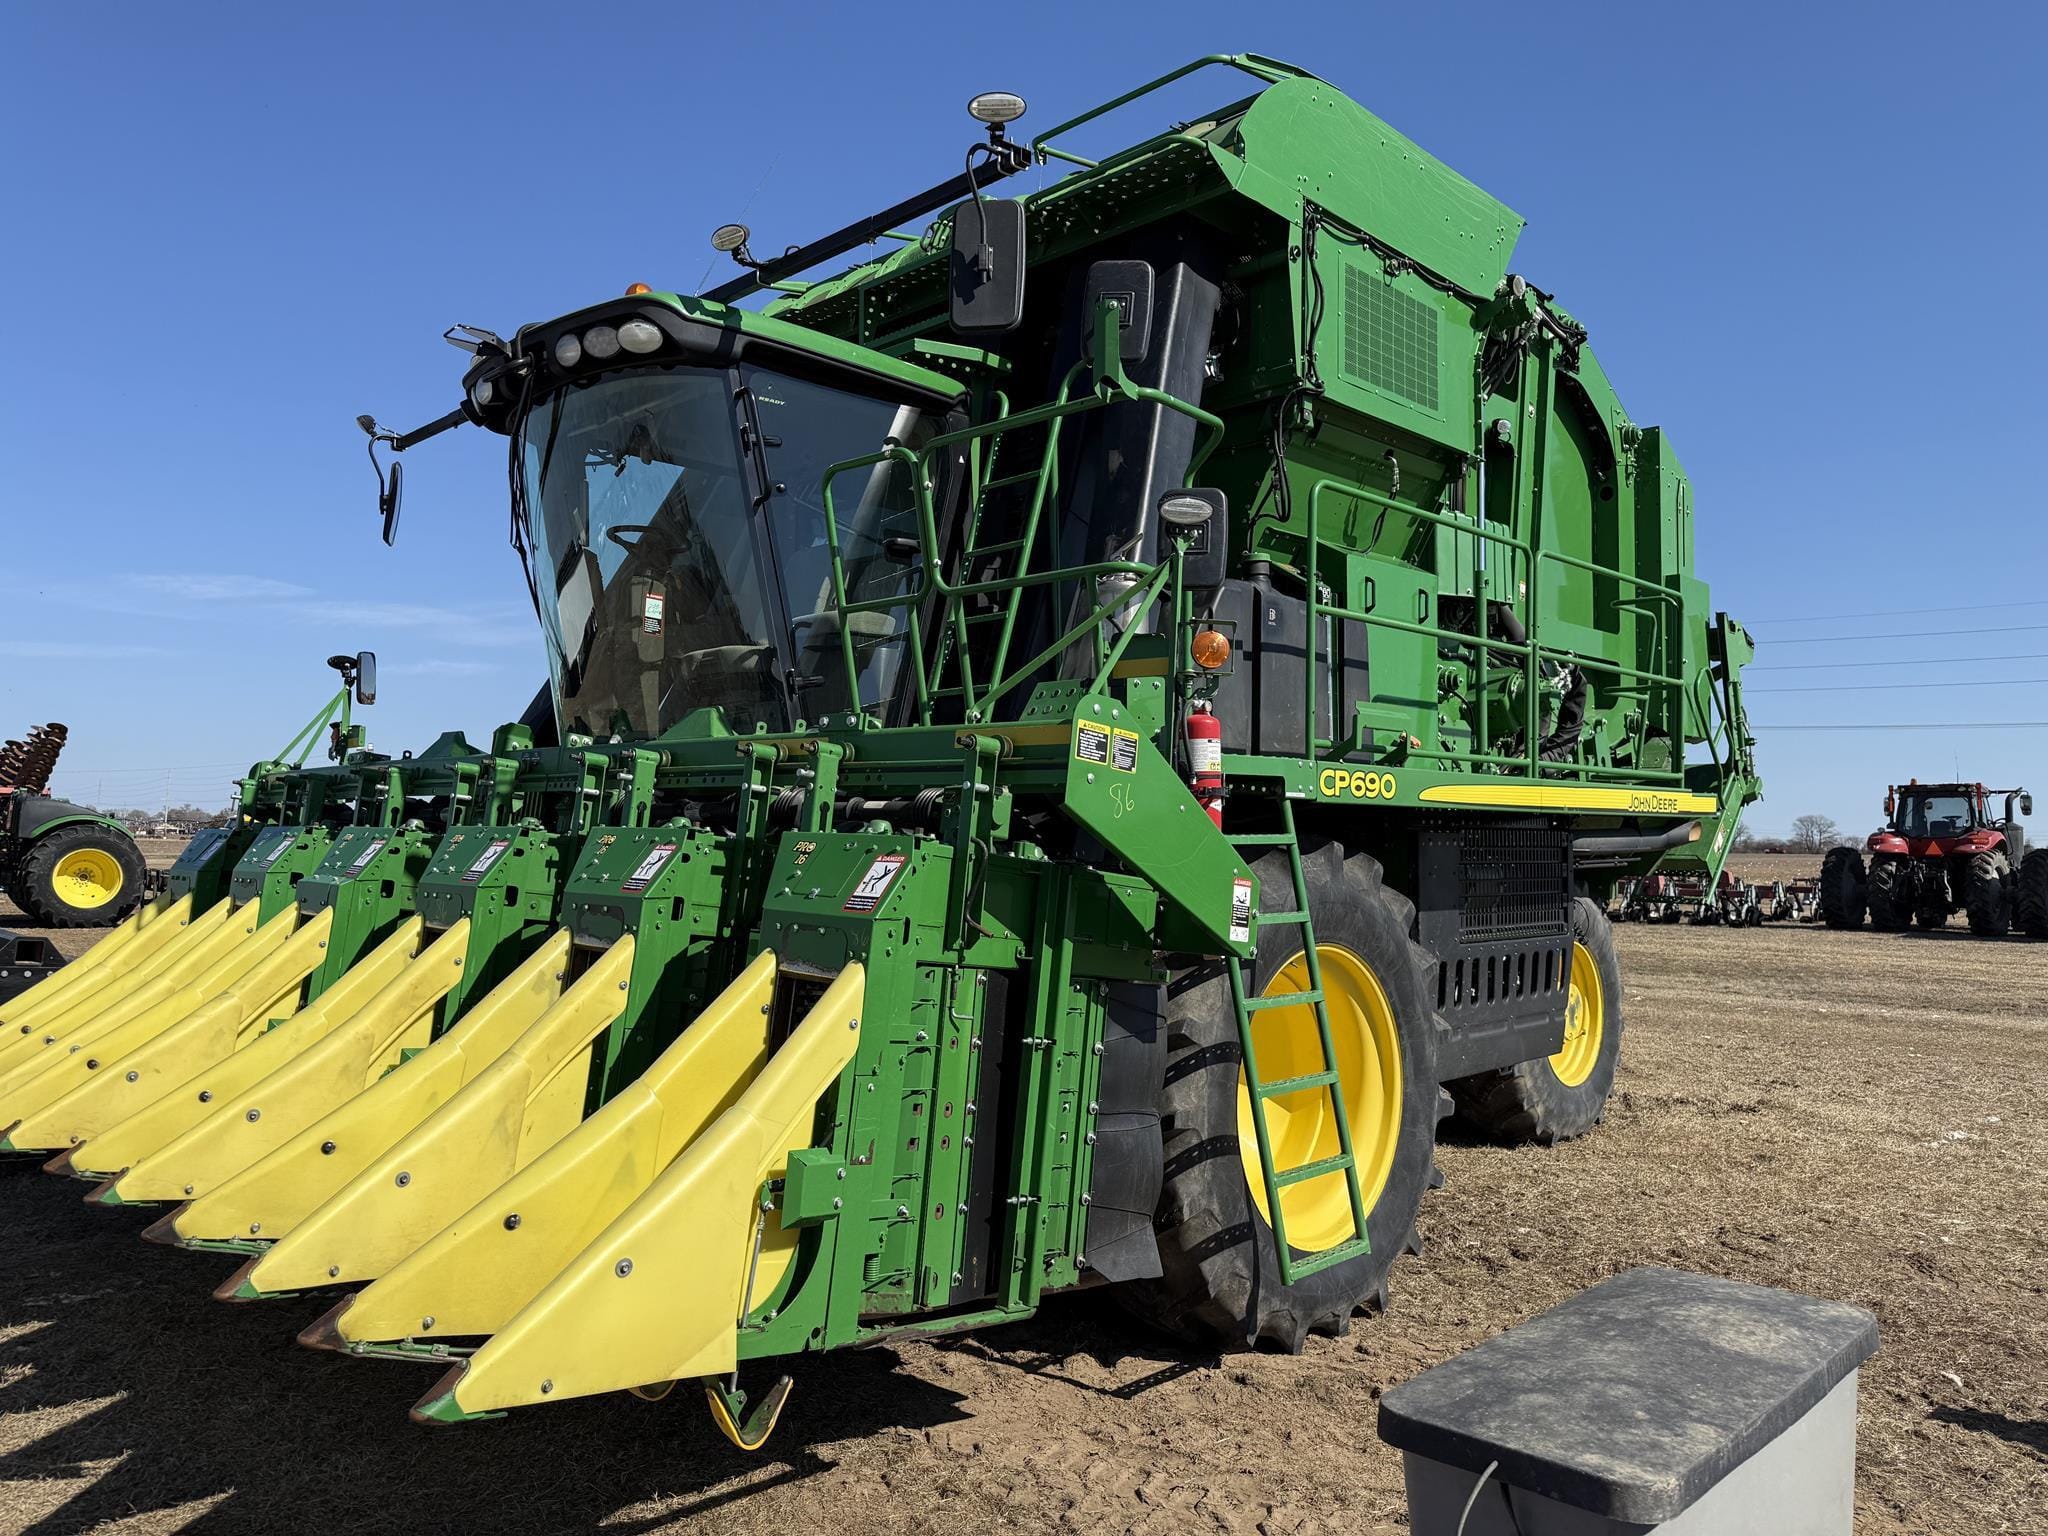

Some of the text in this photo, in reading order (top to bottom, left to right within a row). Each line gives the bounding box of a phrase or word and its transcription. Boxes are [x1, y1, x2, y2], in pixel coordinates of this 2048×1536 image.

[1319, 768, 1397, 800] CP690
[1628, 793, 1678, 811] JOHN DEERE
[793, 841, 816, 853] PRO
[794, 854, 808, 865] 16
